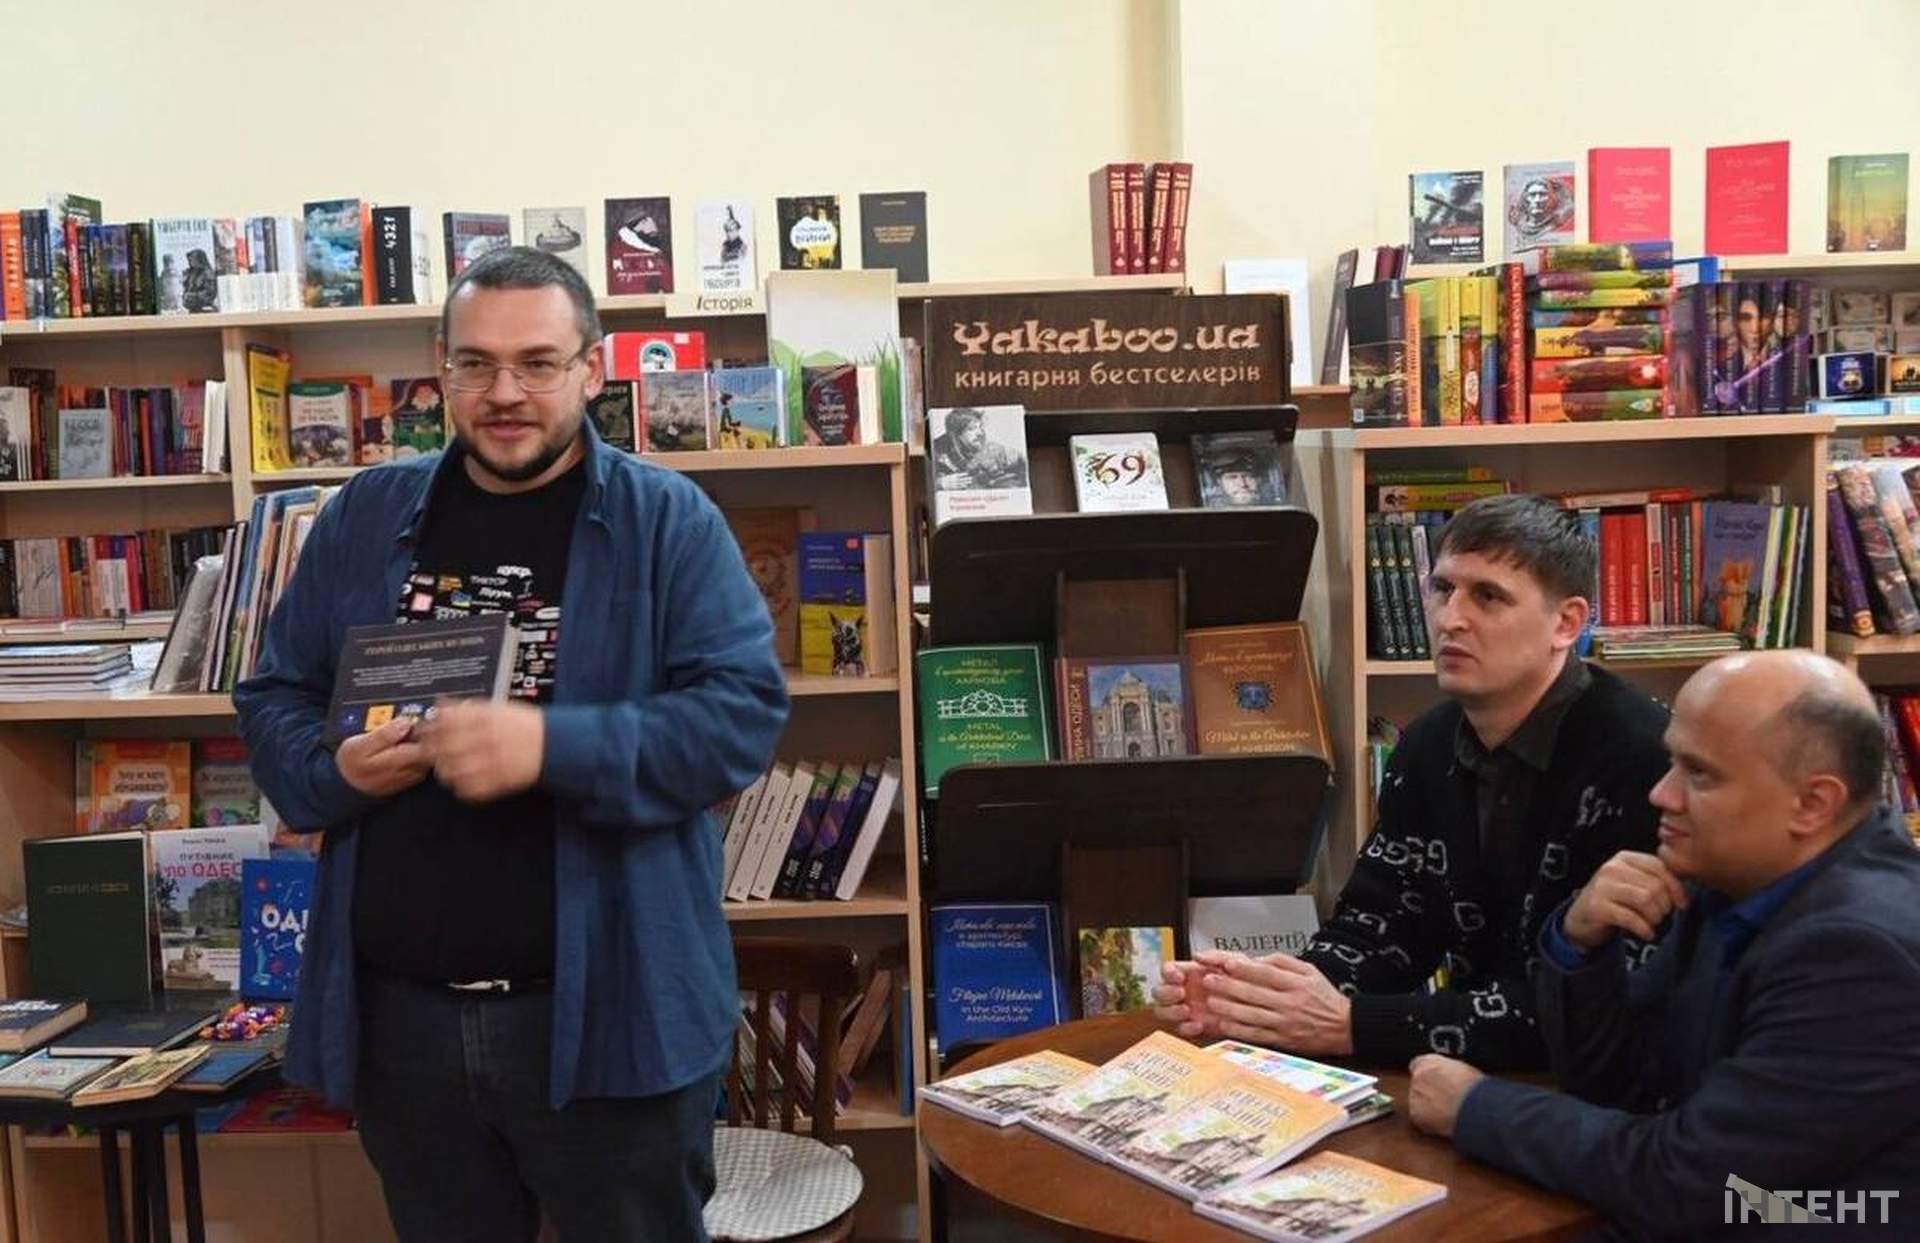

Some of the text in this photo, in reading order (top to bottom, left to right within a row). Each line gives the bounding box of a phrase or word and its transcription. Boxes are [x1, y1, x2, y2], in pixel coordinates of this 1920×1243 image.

[383, 216, 397, 248] 4321
[697, 296, 753, 311] Історія
[953, 318, 1260, 356] Yakaboo.ua
[955, 361, 1260, 390] книгарня бестселерів
[1214, 928, 1306, 952] ВАЛЕРІЙ
